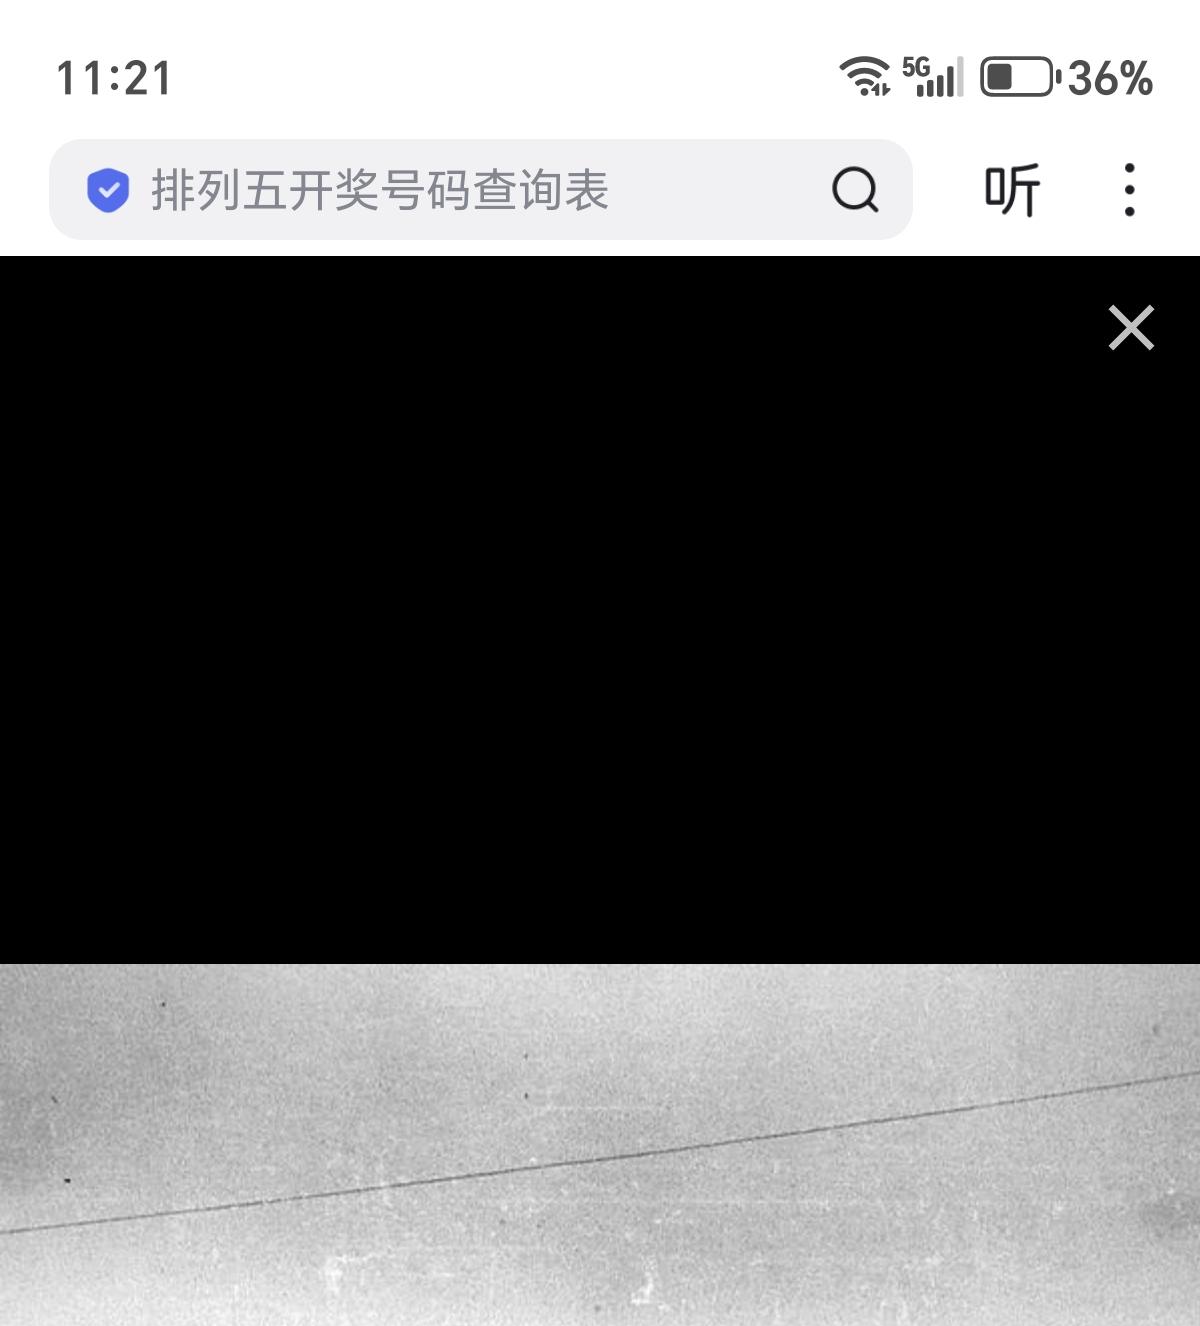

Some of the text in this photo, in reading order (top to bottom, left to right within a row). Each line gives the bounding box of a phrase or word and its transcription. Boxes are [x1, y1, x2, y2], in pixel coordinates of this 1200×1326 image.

[58, 59, 169, 95] 11:21
[902, 56, 931, 78] 5G
[1068, 59, 1154, 96] 36%
[151, 167, 610, 212] 排列五开奖号码查询表
[985, 162, 1041, 218] 听
